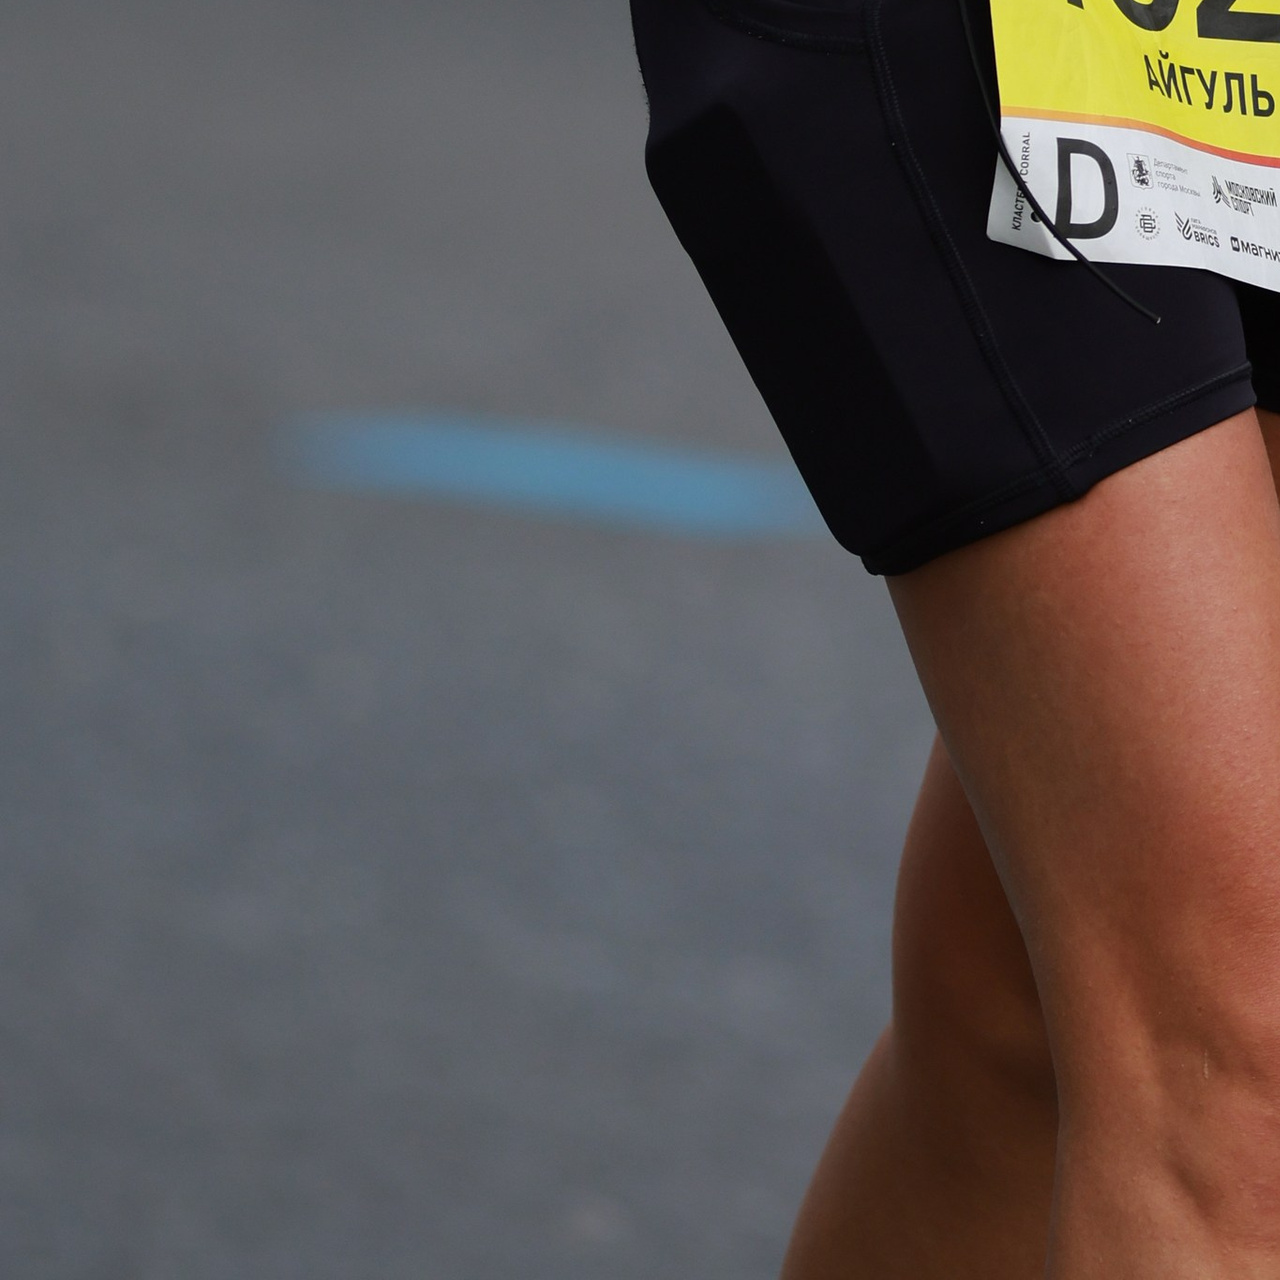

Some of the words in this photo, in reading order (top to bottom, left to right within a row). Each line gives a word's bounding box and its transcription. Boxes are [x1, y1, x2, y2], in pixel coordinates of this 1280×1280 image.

[1144, 50, 1275, 118] АЙГУЛЬ
[1020, 132, 1031, 176] CORRAL
[1012, 185, 1026, 231] КЛАСТЕ
[1054, 137, 1119, 240] D
[1193, 230, 1220, 248] BRICS
